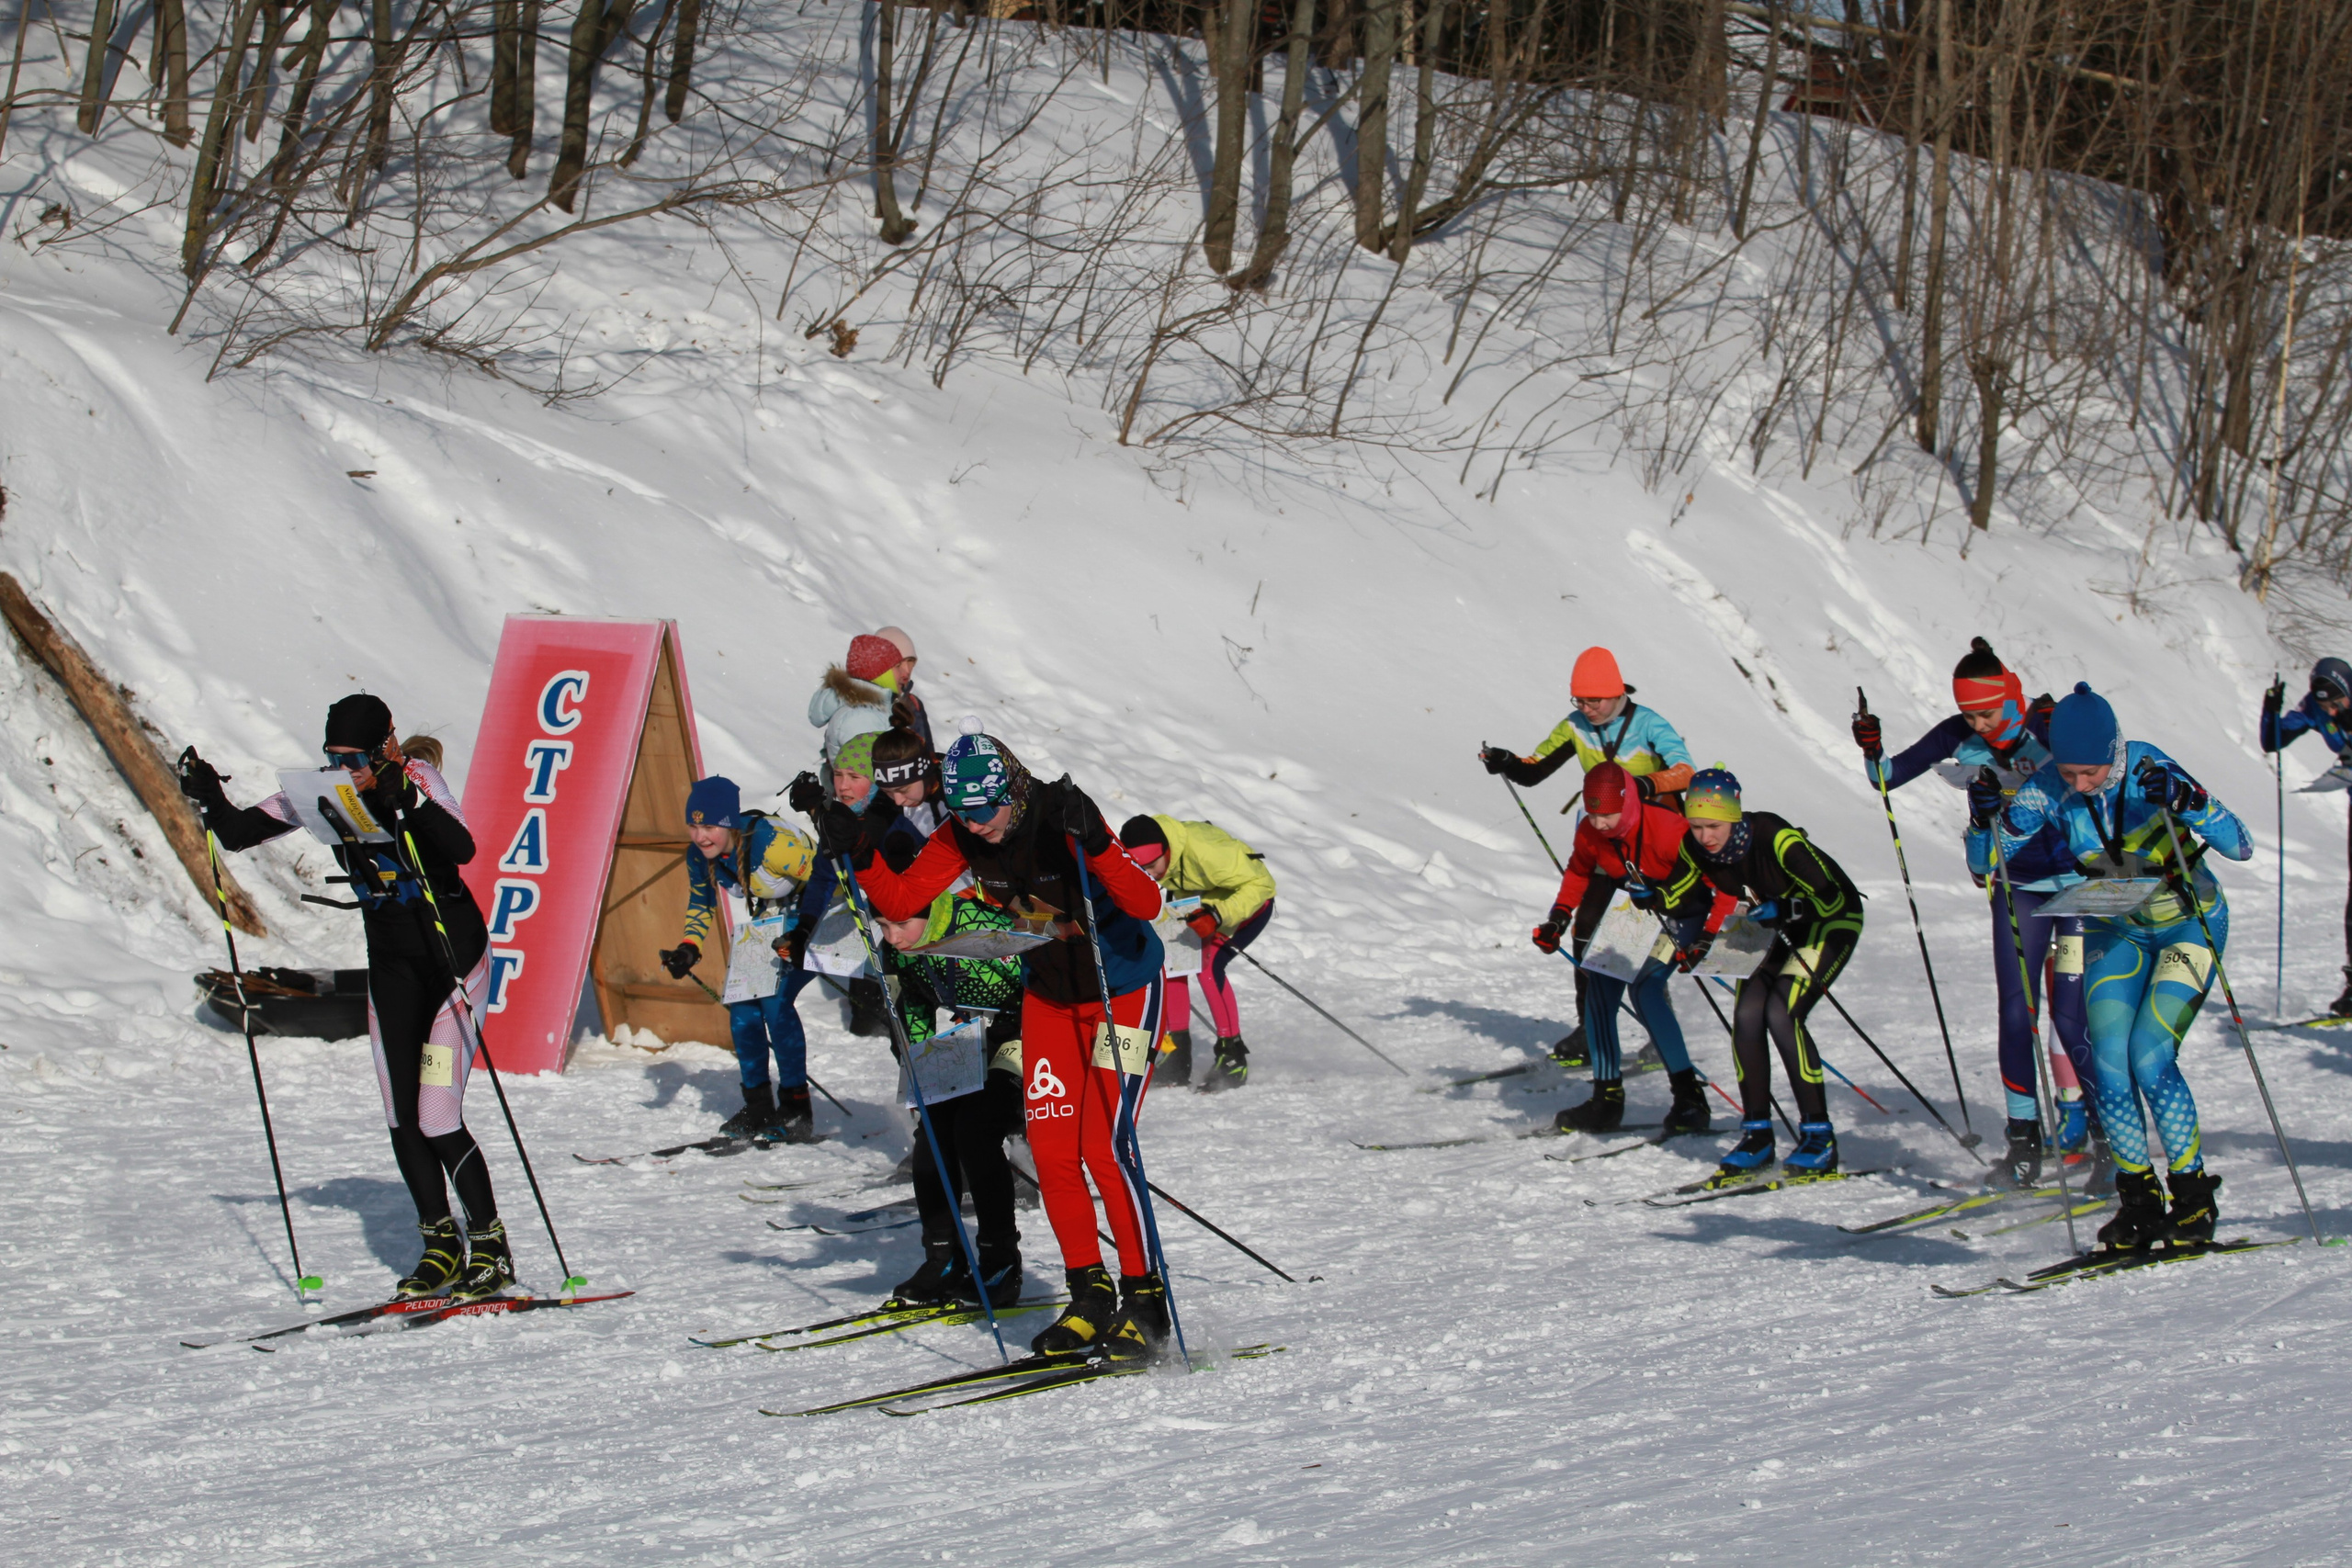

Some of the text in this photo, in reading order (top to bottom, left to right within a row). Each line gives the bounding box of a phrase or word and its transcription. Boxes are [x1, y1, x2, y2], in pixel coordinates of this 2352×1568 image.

[982, 743, 995, 751] 32
[487, 670, 590, 1013] СТАРТ
[2164, 952, 2190, 964] 505
[1103, 1034, 1131, 1051] 506
[1026, 1102, 1074, 1122] odlo
[888, 1309, 930, 1320] FISCHER
